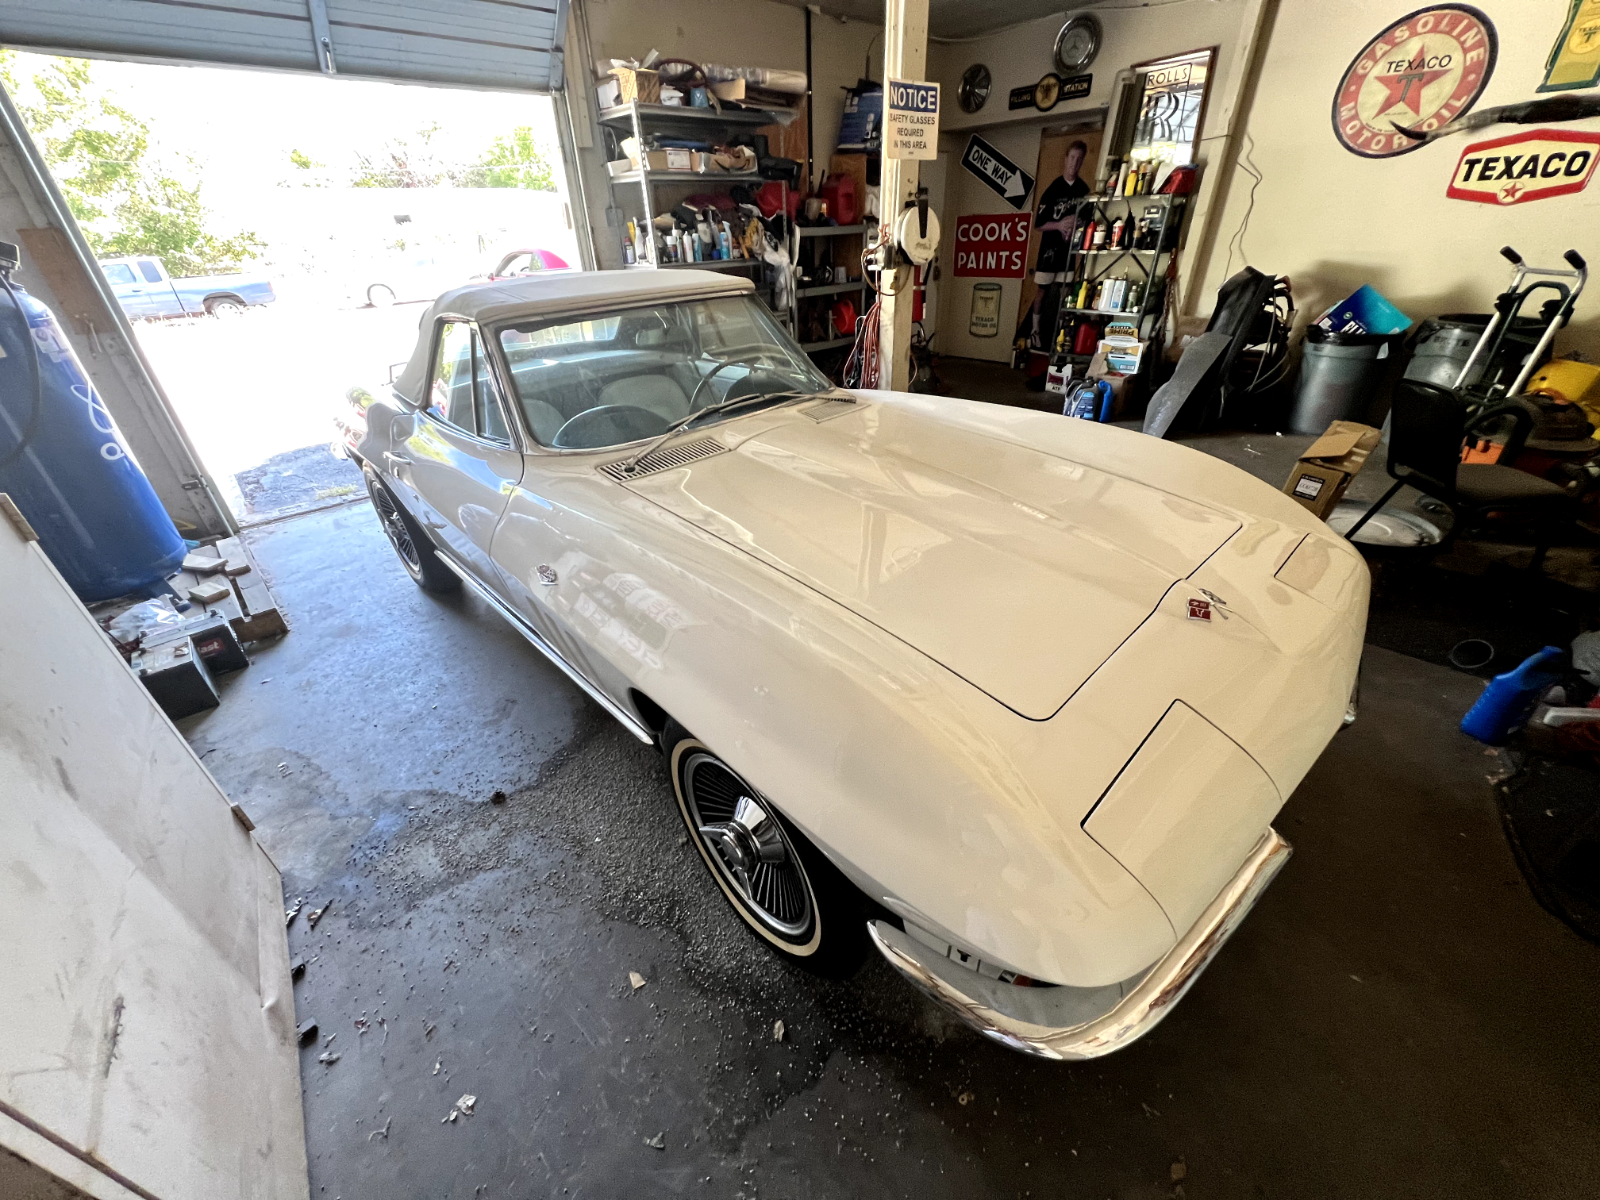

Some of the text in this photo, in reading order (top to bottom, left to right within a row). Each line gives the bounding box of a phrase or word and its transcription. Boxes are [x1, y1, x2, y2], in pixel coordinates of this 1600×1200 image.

[1356, 14, 1485, 76] GASOLINE
[1386, 54, 1453, 74] TEXACO
[1063, 81, 1089, 93] STATION
[1147, 68, 1187, 86] ROLLS
[890, 85, 937, 109] NOTICE
[890, 114, 936, 125] SAFETY GLASSES
[1340, 95, 1468, 150] MOTOR OIL
[897, 127, 924, 137] REQUIRED
[900, 140, 911, 149] THIS
[912, 141, 927, 149] AREA
[971, 149, 1013, 186] ONE WAY
[1462, 150, 1592, 182] TEXACO
[957, 217, 1028, 242] COOK'S
[957, 251, 1022, 271] PAINTS
